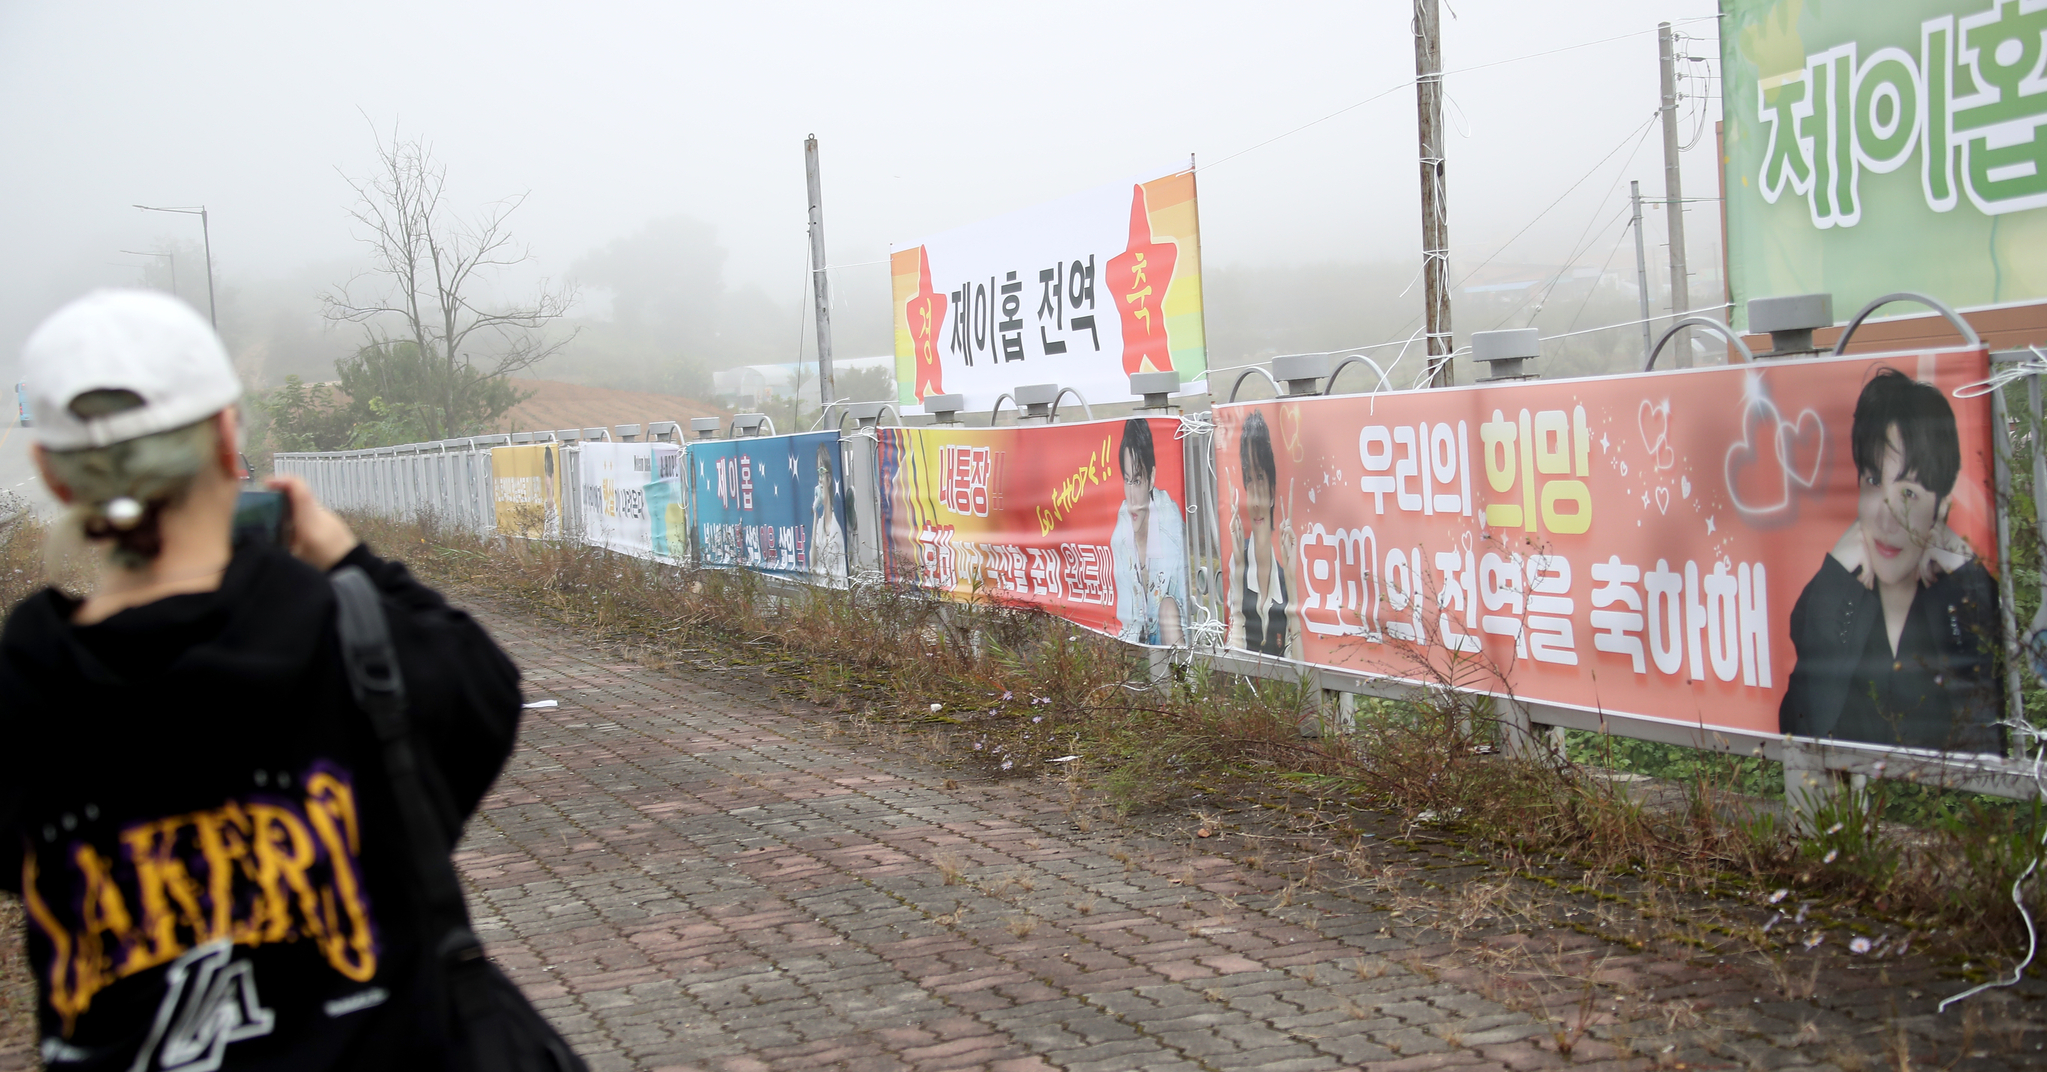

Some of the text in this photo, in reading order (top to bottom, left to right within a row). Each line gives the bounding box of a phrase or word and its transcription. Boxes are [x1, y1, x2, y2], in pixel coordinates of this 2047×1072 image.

[1758, 0, 2047, 229] 제이홉
[918, 297, 933, 365] 경
[950, 253, 1101, 367] 제이홉 전역
[1126, 252, 1152, 336] 축
[1359, 404, 1592, 534] 우리의 희망
[1025, 546, 1063, 599] 준비
[1434, 550, 1579, 666] 전역을
[1590, 554, 1773, 689] 축하해
